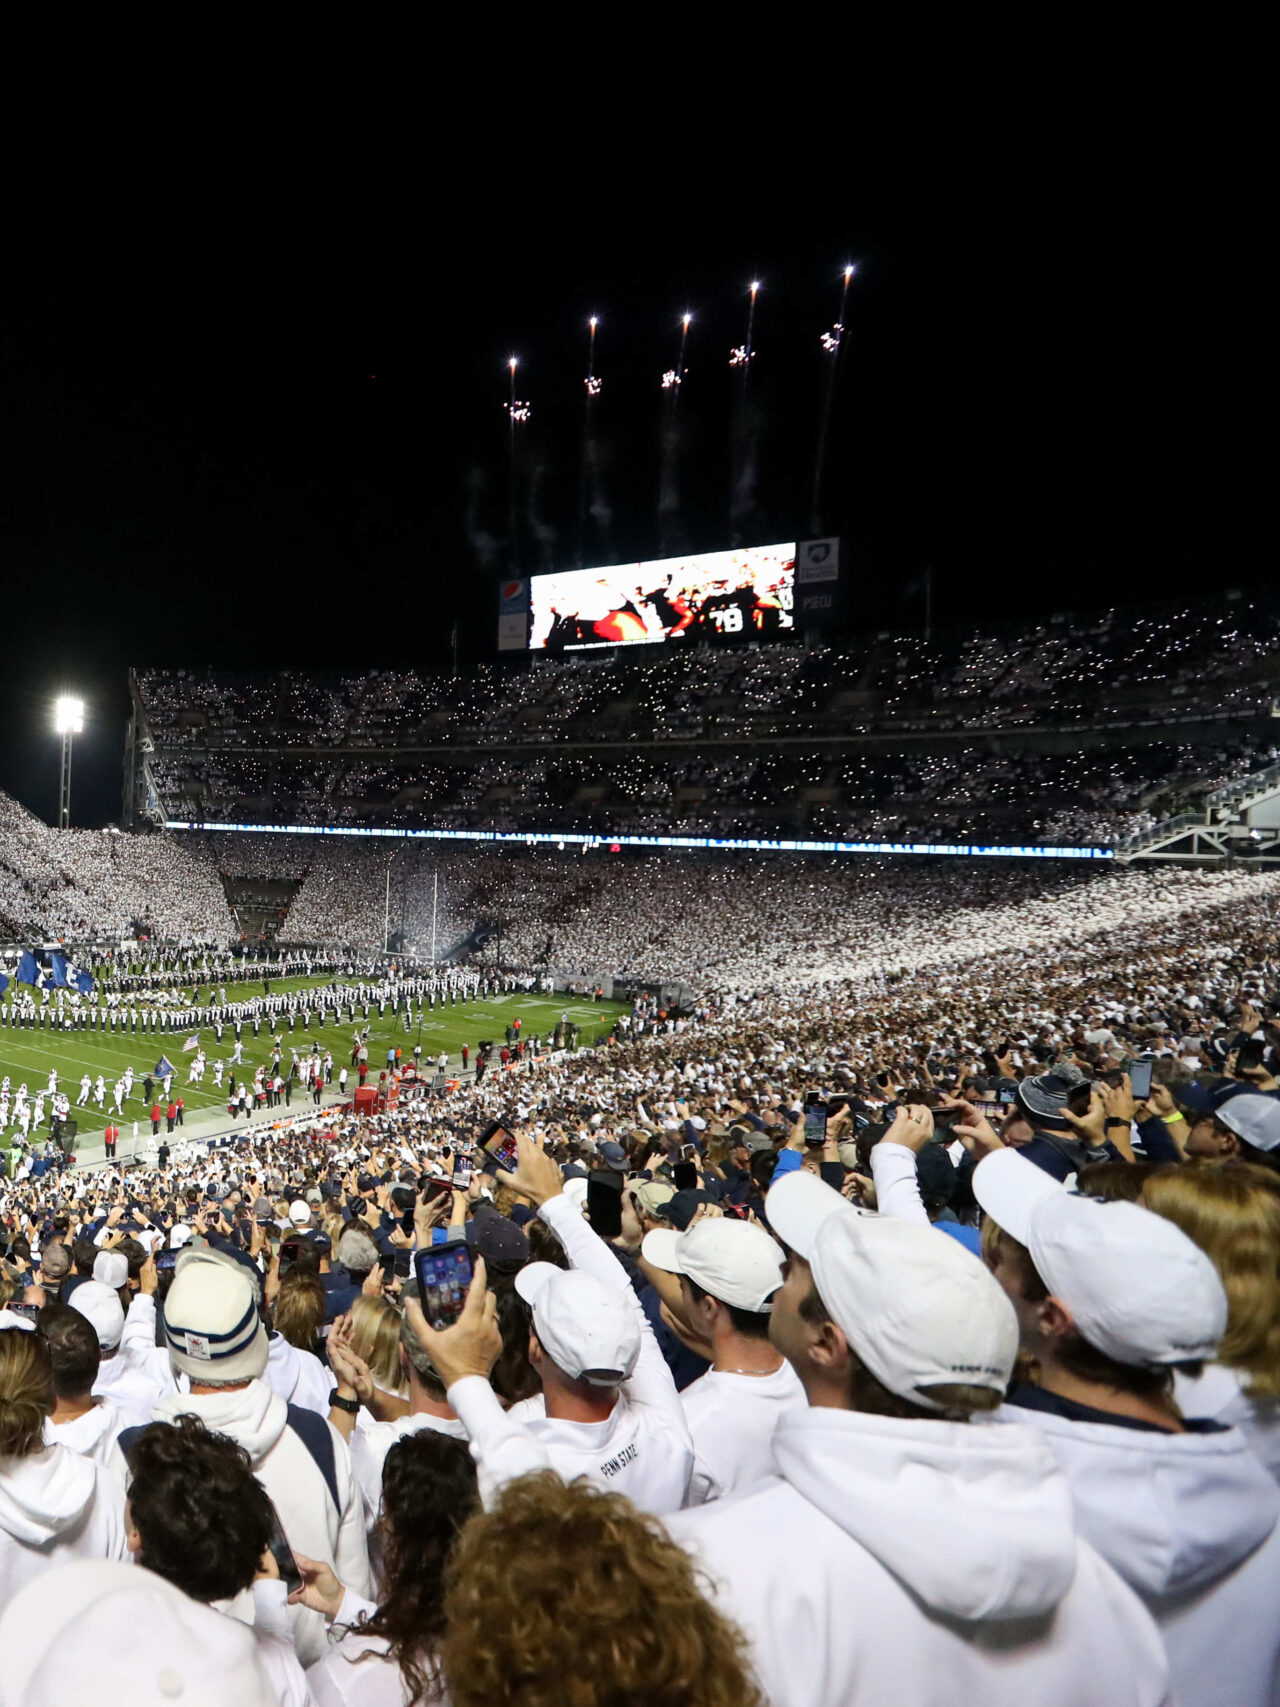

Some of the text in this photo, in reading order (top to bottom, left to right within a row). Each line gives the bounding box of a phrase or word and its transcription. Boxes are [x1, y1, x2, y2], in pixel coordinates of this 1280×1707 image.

[65, 962, 82, 989] E
[600, 1443, 639, 1480] PENN STATE
